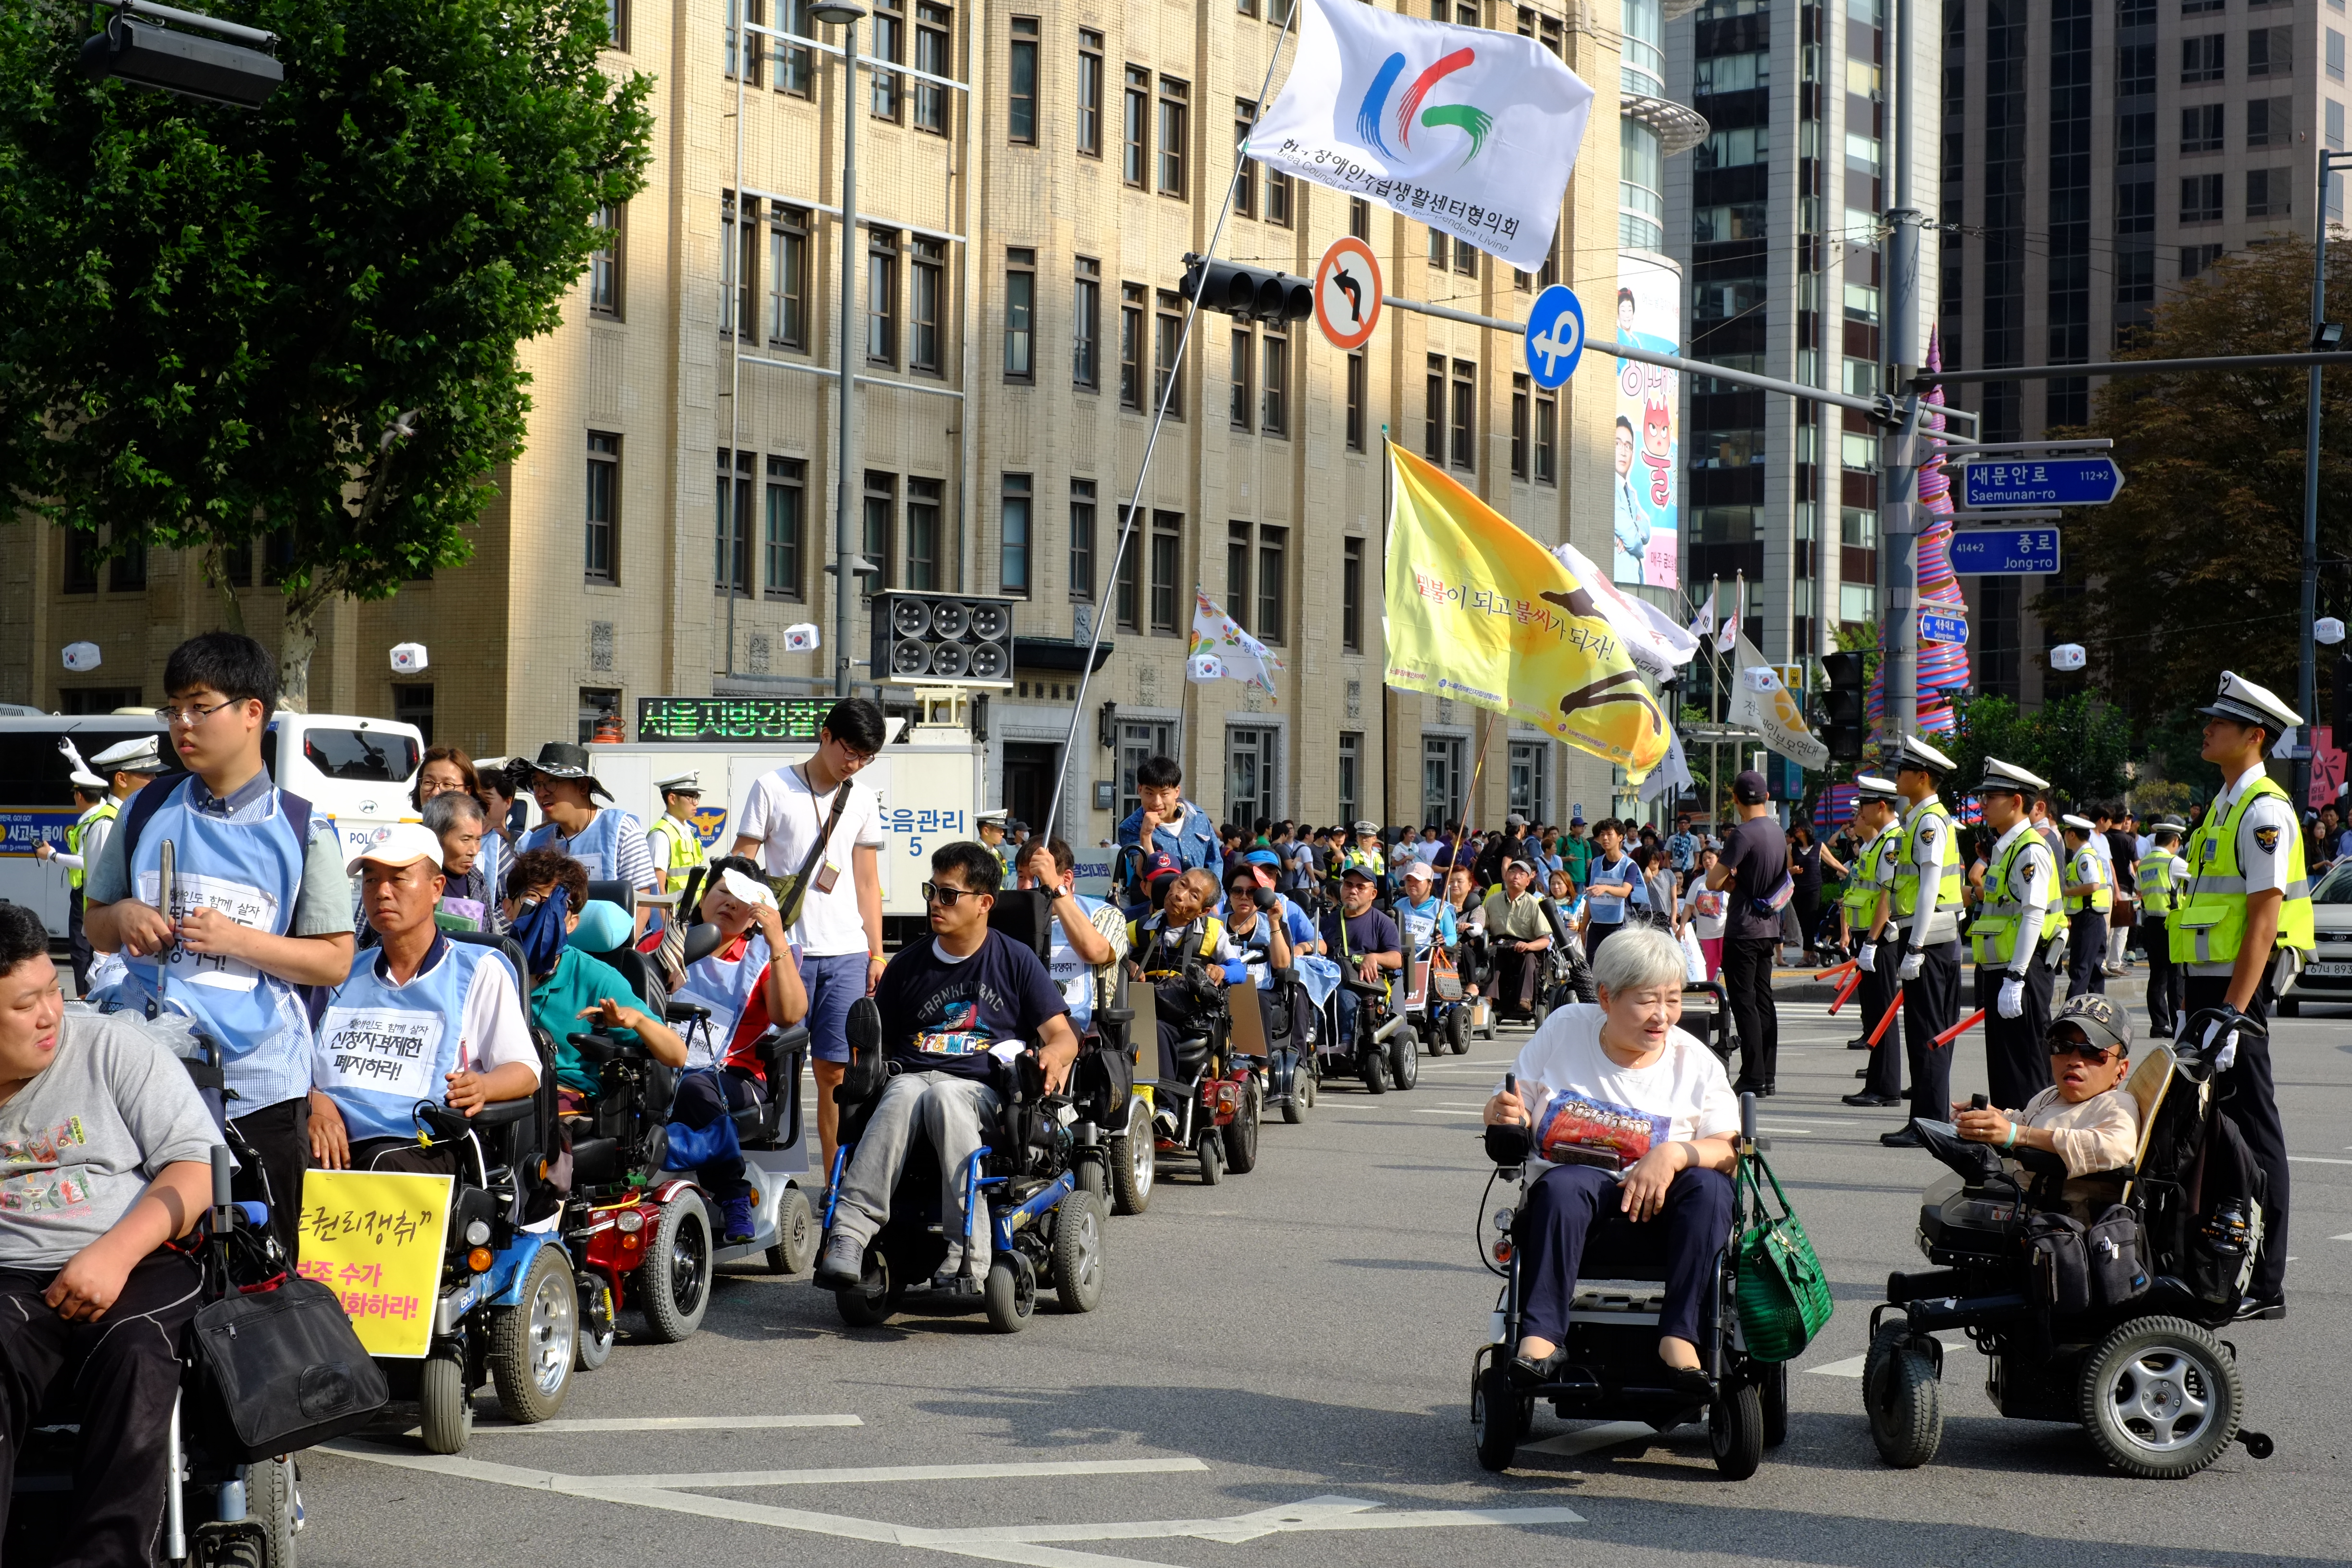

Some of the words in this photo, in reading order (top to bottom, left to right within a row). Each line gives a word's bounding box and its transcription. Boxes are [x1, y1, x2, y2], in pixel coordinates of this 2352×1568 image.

[1279, 138, 1520, 240] 한장애인자립생활센터협의회
[1274, 151, 1300, 166] orea
[1302, 161, 1337, 188] Council
[1395, 202, 1409, 212] for
[1478, 233, 1509, 253] Living
[1972, 466, 2048, 486] 새문안로
[1972, 490, 2056, 502] Saemunan-ro
[2017, 534, 2053, 554] 종로
[1651, 551, 1662, 567] 매주
[2004, 556, 2053, 571] Jong-ro
[1417, 573, 1467, 611] 밑불이
[1471, 590, 1512, 615] 되고
[1514, 600, 1567, 640] 불씨가
[1568, 627, 1615, 660] 되자!
[1935, 618, 1955, 631] 세종대로
[8, 825, 40, 842] 사고는
[909, 836, 922, 857] 5
[209, 895, 233, 912] 함께
[237, 903, 261, 919] 살자
[388, 1023, 406, 1033] 함께
[410, 1025, 429, 1036] 살자
[331, 1030, 423, 1058] 신청자격제한
[333, 1054, 403, 1081] 폐지하라!
[338, 1263, 382, 1288] 수가
